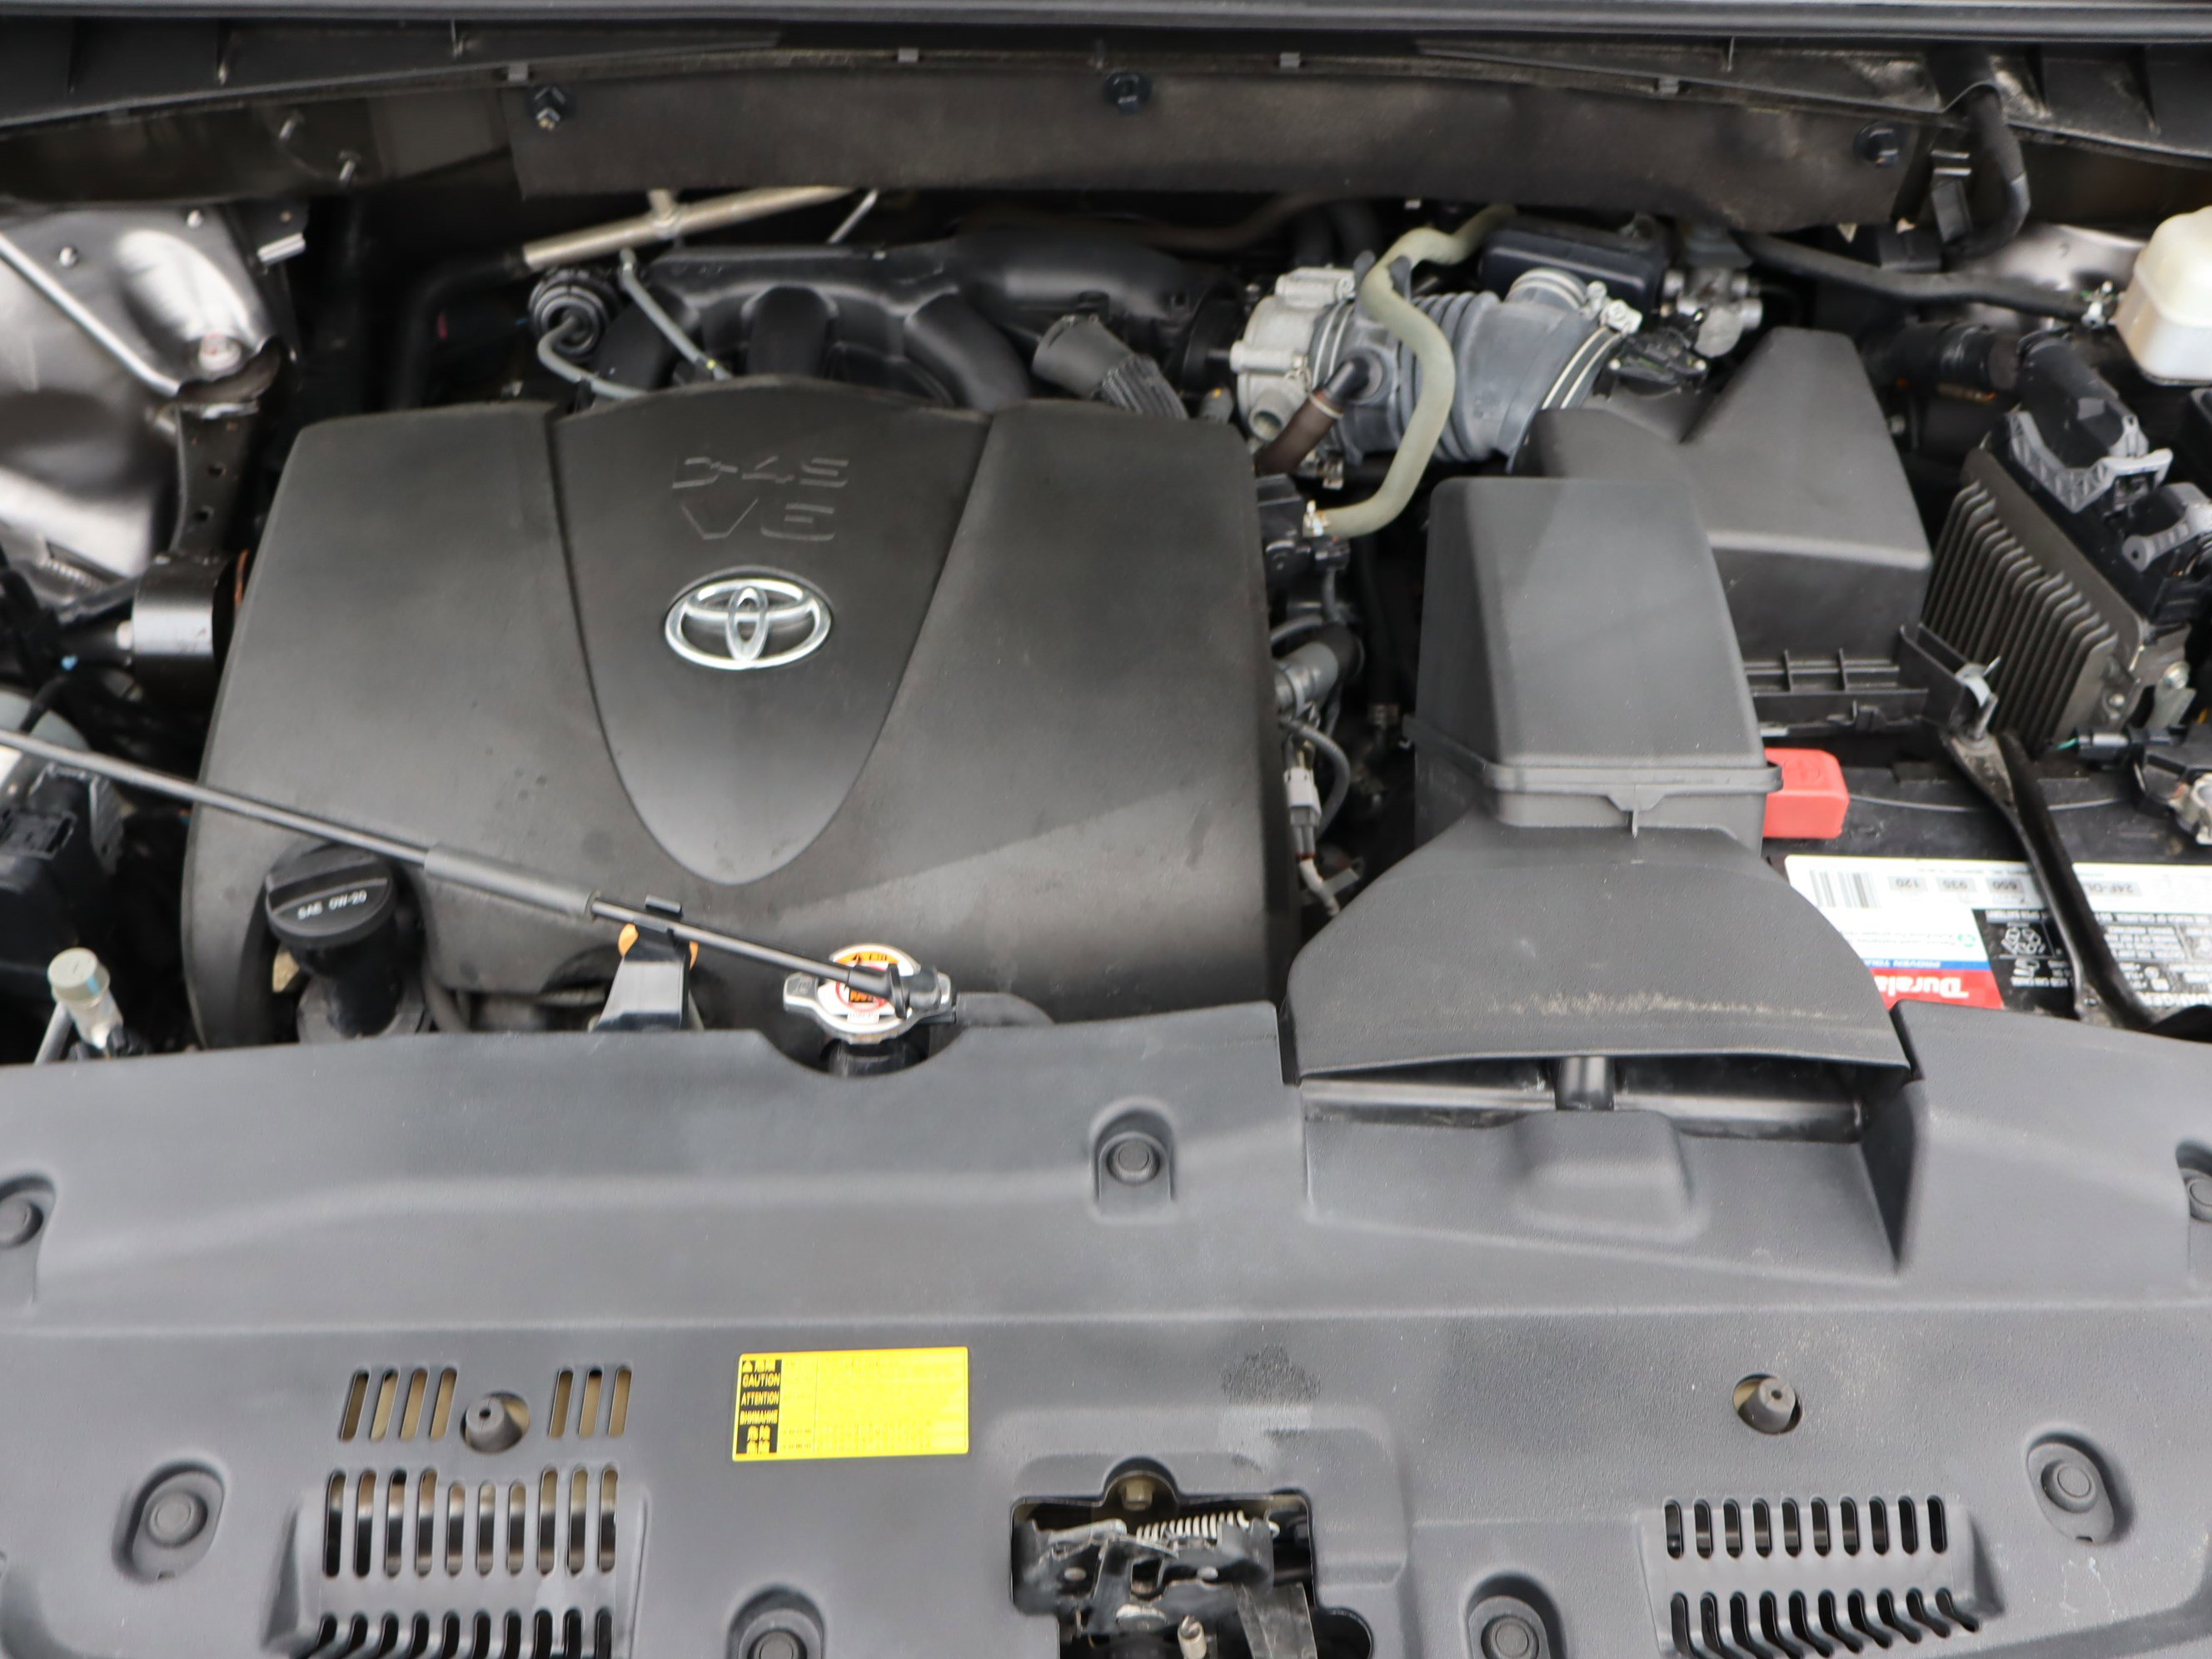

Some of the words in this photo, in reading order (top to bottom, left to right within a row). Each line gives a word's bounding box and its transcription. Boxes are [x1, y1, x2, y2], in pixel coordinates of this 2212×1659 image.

[1874, 975, 1969, 999] Durala
[742, 1373, 780, 1388] CAUTION
[740, 1391, 780, 1406] ATTENTION
